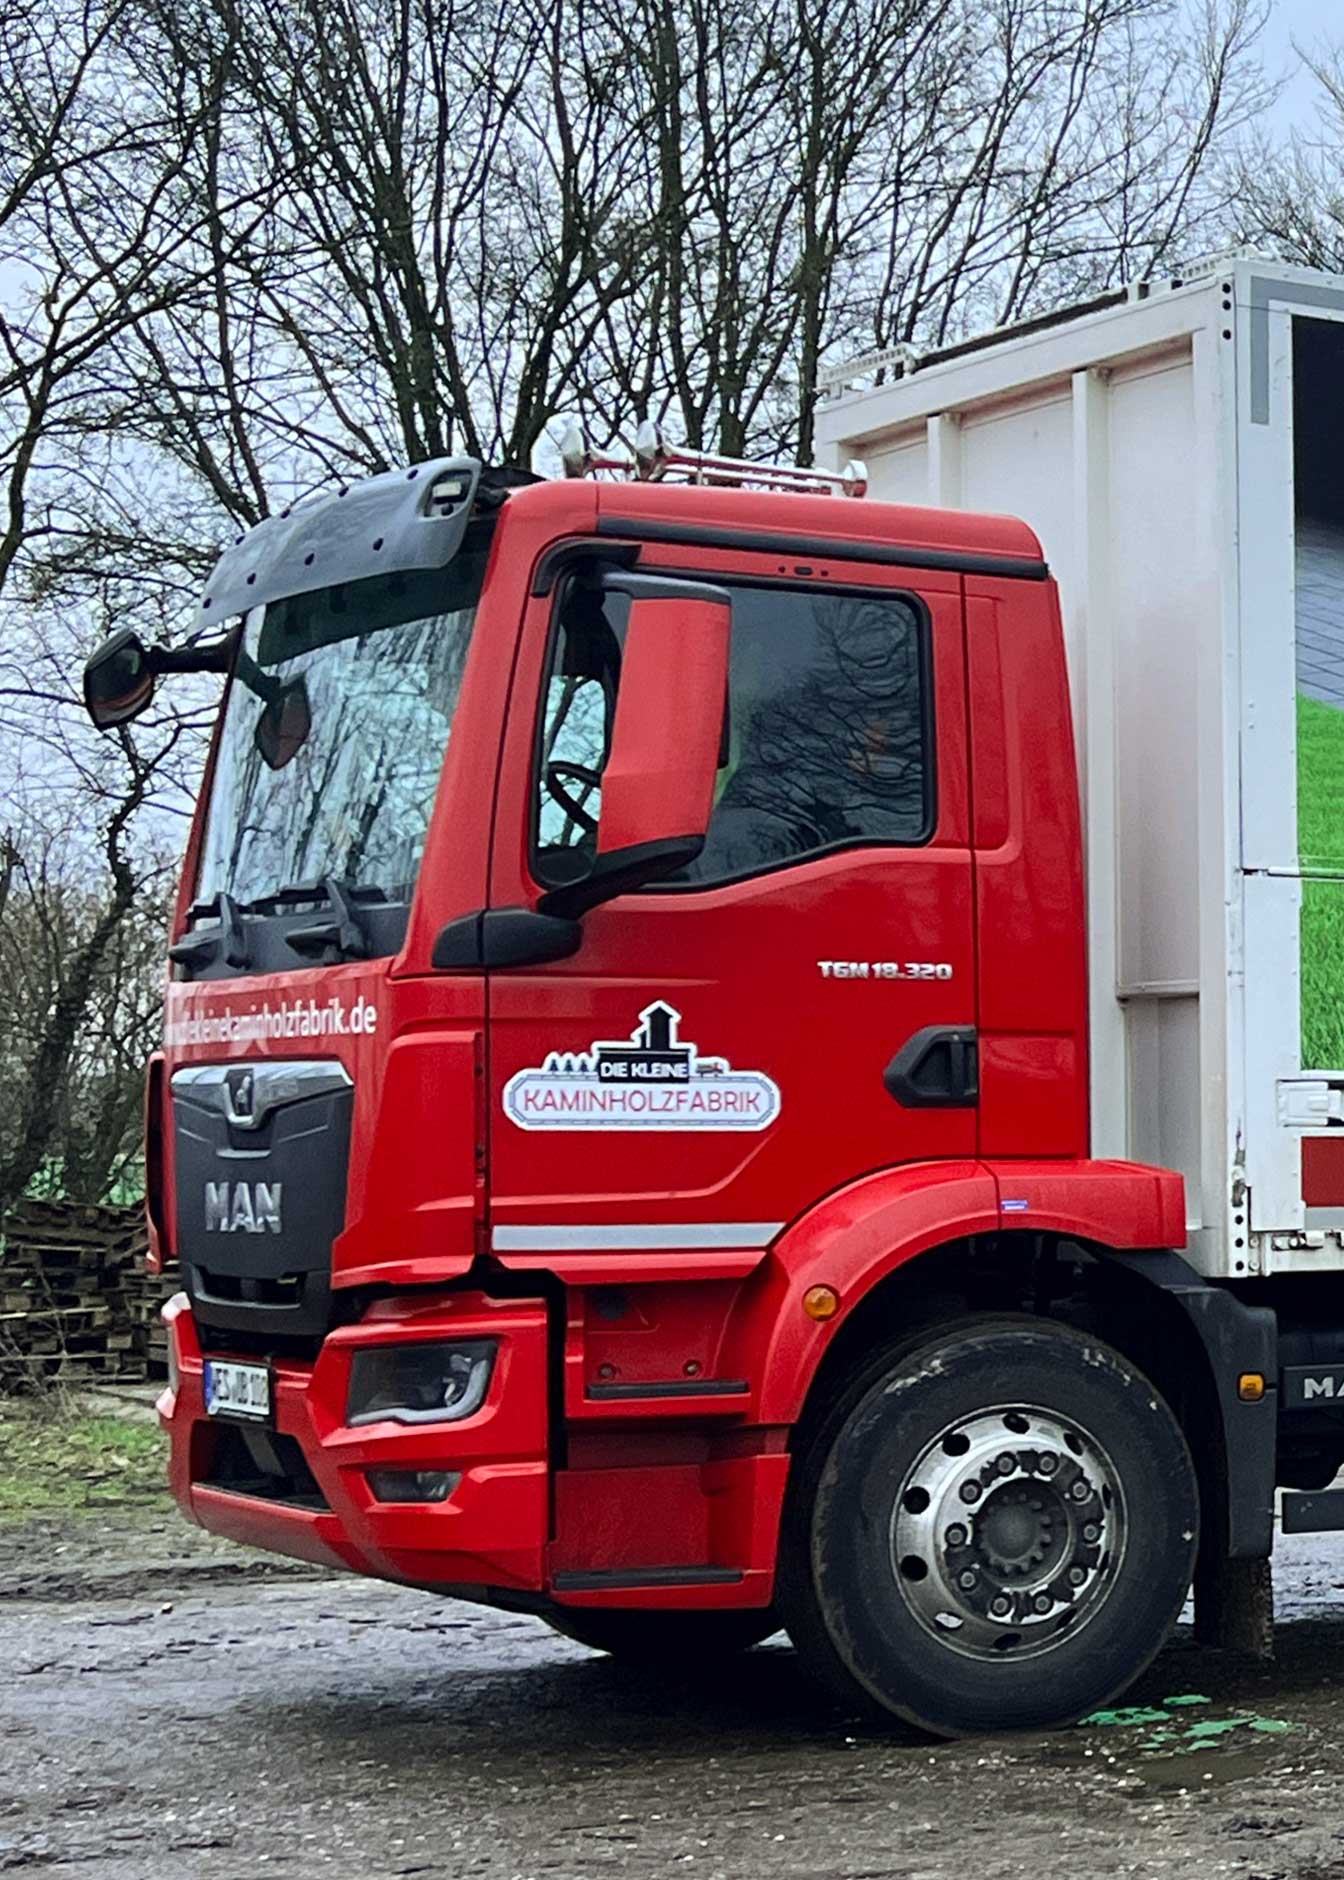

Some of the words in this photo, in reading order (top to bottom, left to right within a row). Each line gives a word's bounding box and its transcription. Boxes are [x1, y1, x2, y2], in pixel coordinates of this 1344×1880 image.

[817, 960, 869, 978] TGM
[871, 962, 953, 980] 18.320
[600, 1063, 628, 1078] DIE
[631, 1062, 689, 1079] KLEINE
[523, 1088, 761, 1114] KAMINHOLZFABRIK
[204, 1181, 282, 1233] MAN
